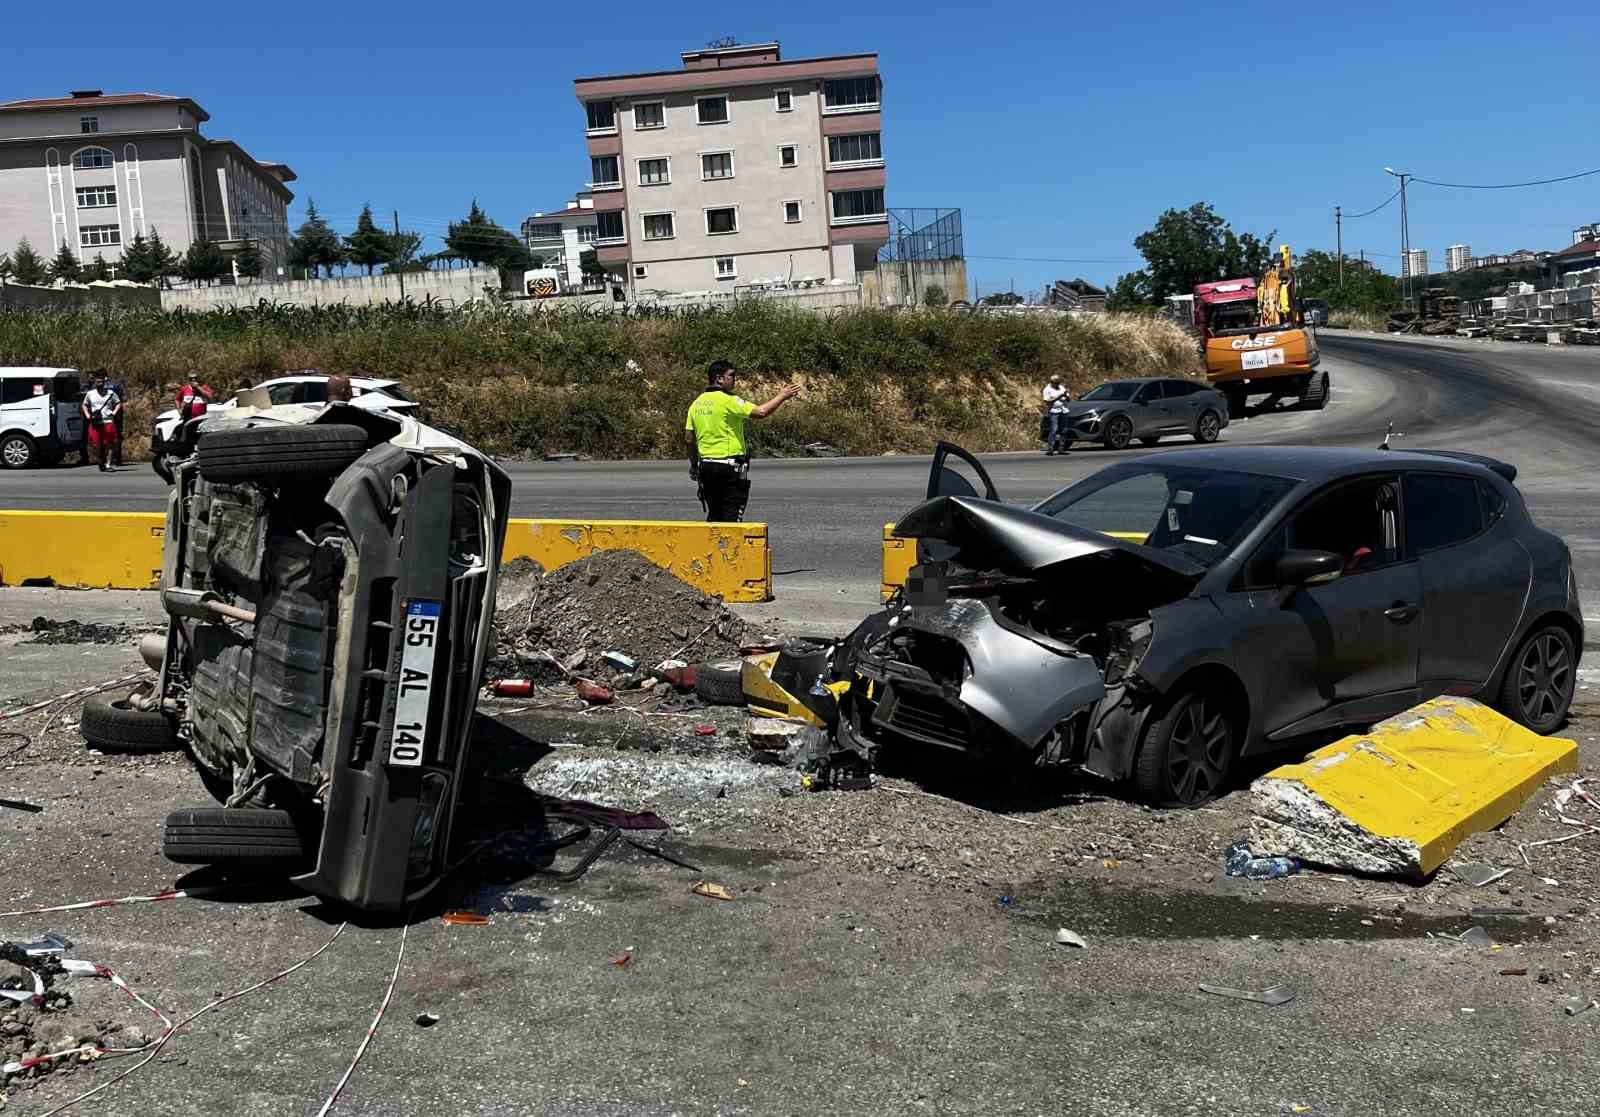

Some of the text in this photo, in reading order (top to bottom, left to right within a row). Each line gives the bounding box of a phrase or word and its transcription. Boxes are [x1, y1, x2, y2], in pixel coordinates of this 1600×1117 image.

[1231, 336, 1276, 349] CASE
[407, 618, 435, 647] 55
[400, 668, 429, 698] AL
[392, 722, 423, 760] 140
